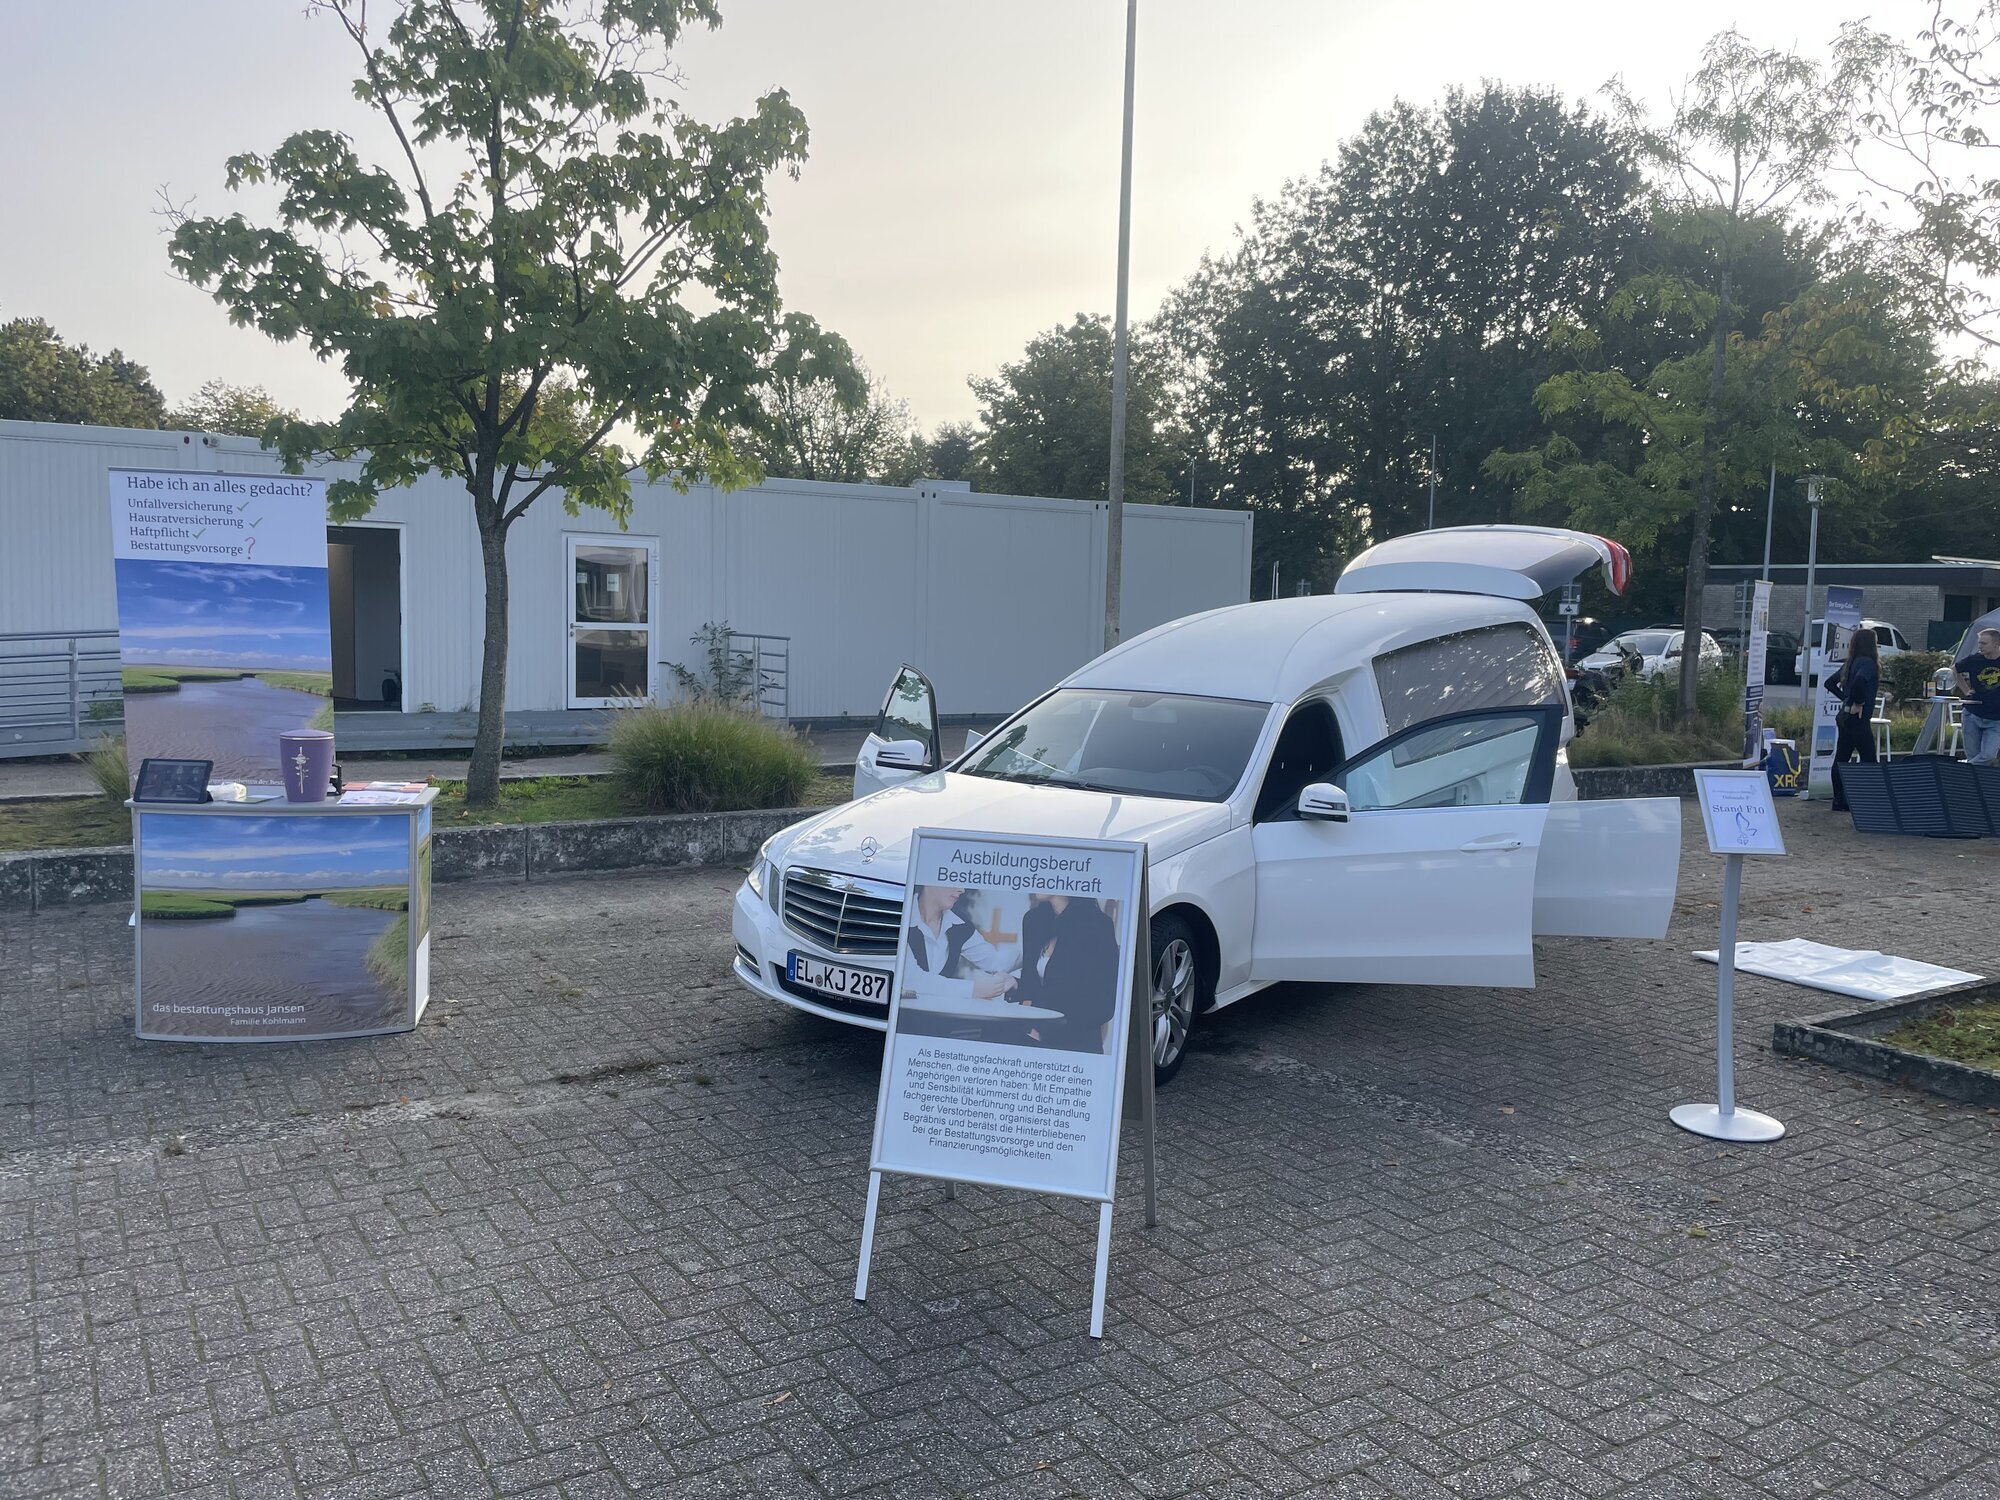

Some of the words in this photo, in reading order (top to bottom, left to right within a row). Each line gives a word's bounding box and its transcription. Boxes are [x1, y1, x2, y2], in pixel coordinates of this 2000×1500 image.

[127, 477, 163, 490] Habe
[167, 478, 188, 491] ich
[192, 482, 210, 492] an
[213, 480, 246, 493] alles
[250, 482, 312, 497] gedacht?
[128, 499, 233, 514] Unfallversicherung
[129, 513, 244, 529] Hausratversicherung
[130, 526, 189, 539] Haftpflicht
[1712, 805, 1743, 813] Stand
[1746, 805, 1765, 815] F10
[951, 849, 1092, 872] Ausbildungsberuf
[937, 867, 1102, 893] Bestattungsfachkraft
[152, 1003, 171, 1013] das
[173, 1003, 264, 1017] bestattungshaus
[266, 1004, 305, 1016] Jansen
[230, 1018, 260, 1026] Familie
[262, 1017, 306, 1026] Kohlmann
[908, 1058, 954, 1072] Menschen,
[956, 1063, 970, 1073] die
[972, 1066, 991, 1075] eine
[992, 1067, 1043, 1081] Angehörige
[1045, 1073, 1065, 1082] oder
[1067, 1076, 1093, 1086] einen
[918, 1048, 932, 1057] Als
[934, 1049, 1021, 1067] Bestattungsfachkraft
[1024, 1061, 1070, 1072] unterstützt
[1072, 1065, 1084, 1074] du
[906, 1068, 960, 1083] Angehörigen
[963, 1076, 998, 1086] verloren
[1033, 1082, 1047, 1092] Mit
[1049, 1084, 1092, 1097] Empathie
[909, 1081, 925, 1090] und
[927, 1081, 974, 1095] Sensibilität
[976, 1087, 1019, 1100] kümmerst
[1021, 1092, 1033, 1102] du
[1035, 1094, 1054, 1104] dich
[1056, 1098, 1070, 1106] um
[1073, 1099, 1087, 1108] die
[903, 1090, 959, 1104] fachgerechte
[961, 1095, 1015, 1113] Überführung
[1018, 1104, 1034, 1113] und
[1037, 1105, 1091, 1122] Behandlung
[920, 1103, 935, 1112] der
[937, 1104, 997, 1121] Verstorbenen,
[999, 1113, 1051, 1126] organisierst
[1053, 1120, 1070, 1129] das
[903, 1112, 946, 1125] Begräbnis
[948, 1119, 965, 1127] und
[967, 1120, 998, 1131] berätst
[1000, 1123, 1013, 1133] die
[1016, 1125, 1086, 1142] Hinterbliebenen
[912, 1124, 926, 1133] bei
[928, 1126, 942, 1136] der
[944, 1128, 1034, 1149] Bestattungsvorsorge
[1037, 1140, 1054, 1150] und
[1056, 1142, 1074, 1152] den
[929, 1137, 1053, 1160] Finanzierungsmöglichkeiten.
